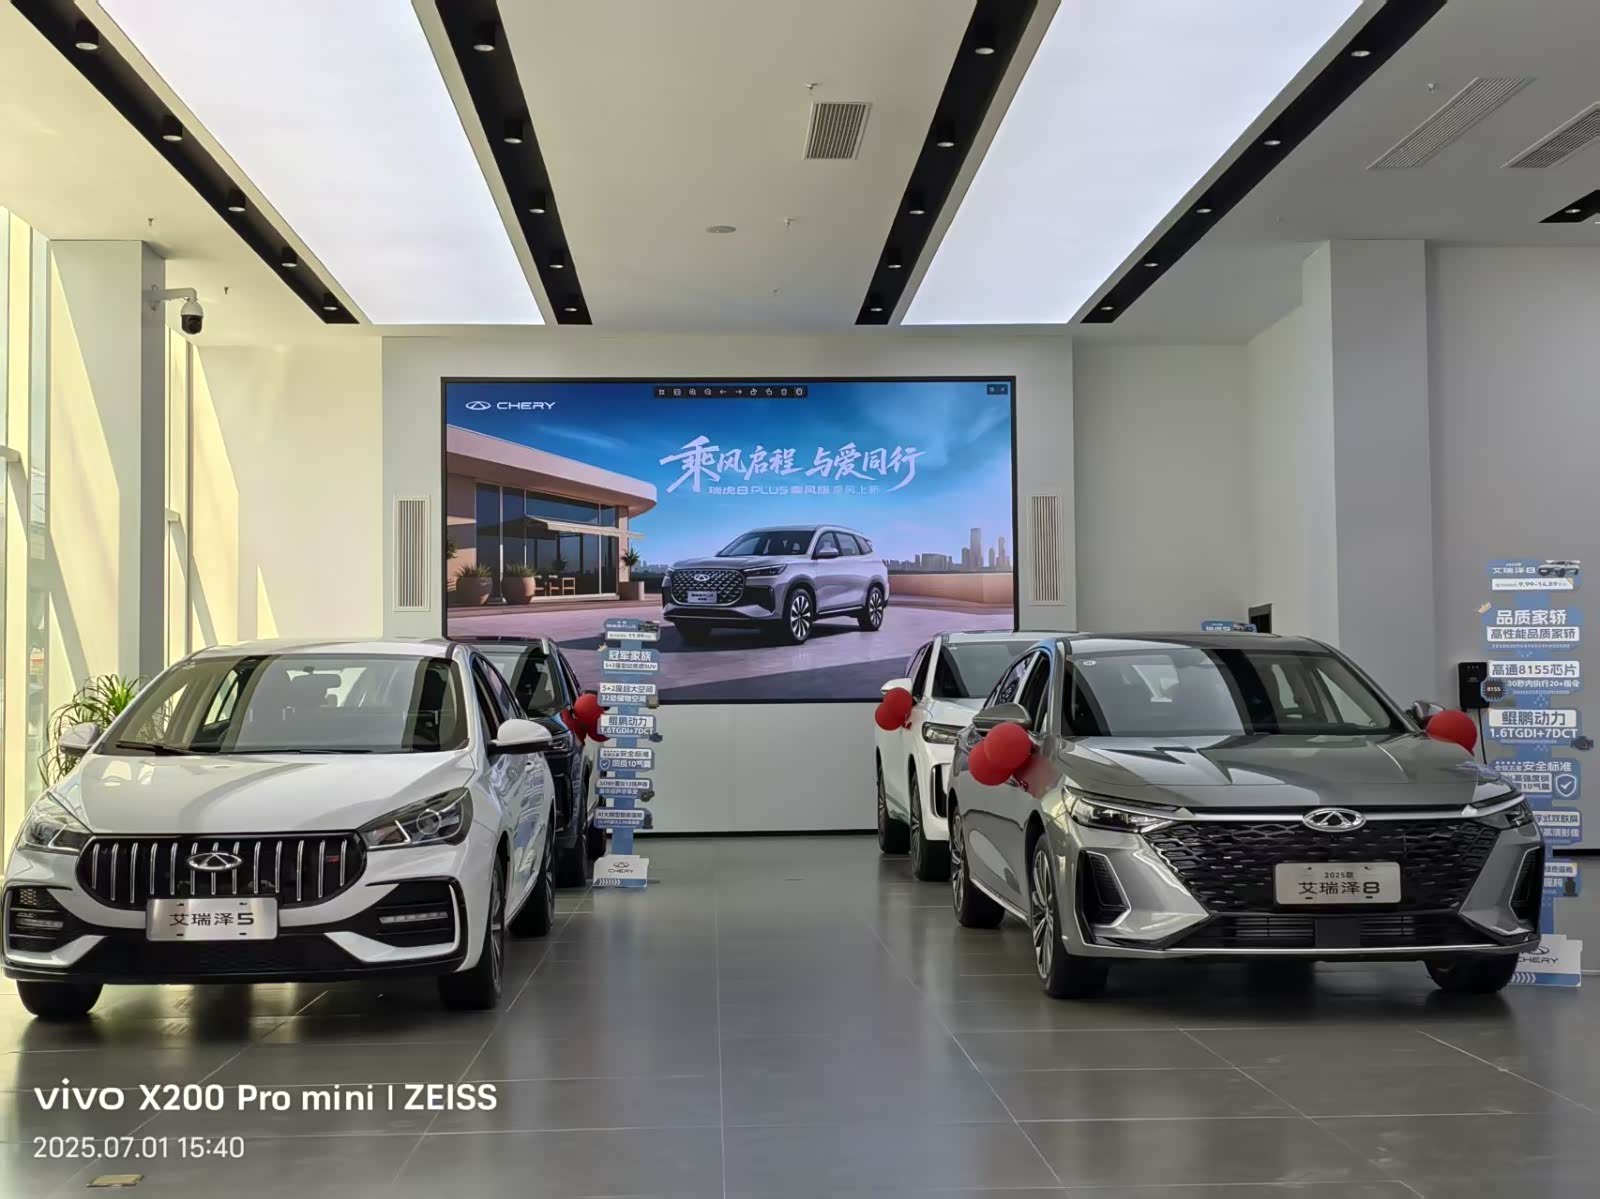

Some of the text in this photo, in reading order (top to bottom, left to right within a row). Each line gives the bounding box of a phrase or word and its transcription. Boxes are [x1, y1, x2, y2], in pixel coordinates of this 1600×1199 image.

[497, 401, 556, 410] CHERY
[659, 435, 926, 493] 乘风启程 与爱同行
[751, 487, 788, 495] PLUS
[1496, 609, 1567, 625] 品质家轿
[1491, 628, 1575, 640] 高性能品质家轿
[608, 650, 652, 661] 冠军家族
[1492, 664, 1576, 676] 高通8155芯片
[608, 716, 647, 726] 鲲鹏动力
[1501, 711, 1566, 726] 鲲鹏动力
[601, 727, 653, 735] 1.6TGDI+7DCT
[1490, 728, 1578, 738] 1.6TGDI+7DCT
[1522, 761, 1572, 772] 安全标准
[1298, 881, 1380, 895] 艾瑞泽8
[169, 912, 255, 926] 艾瑞泽5
